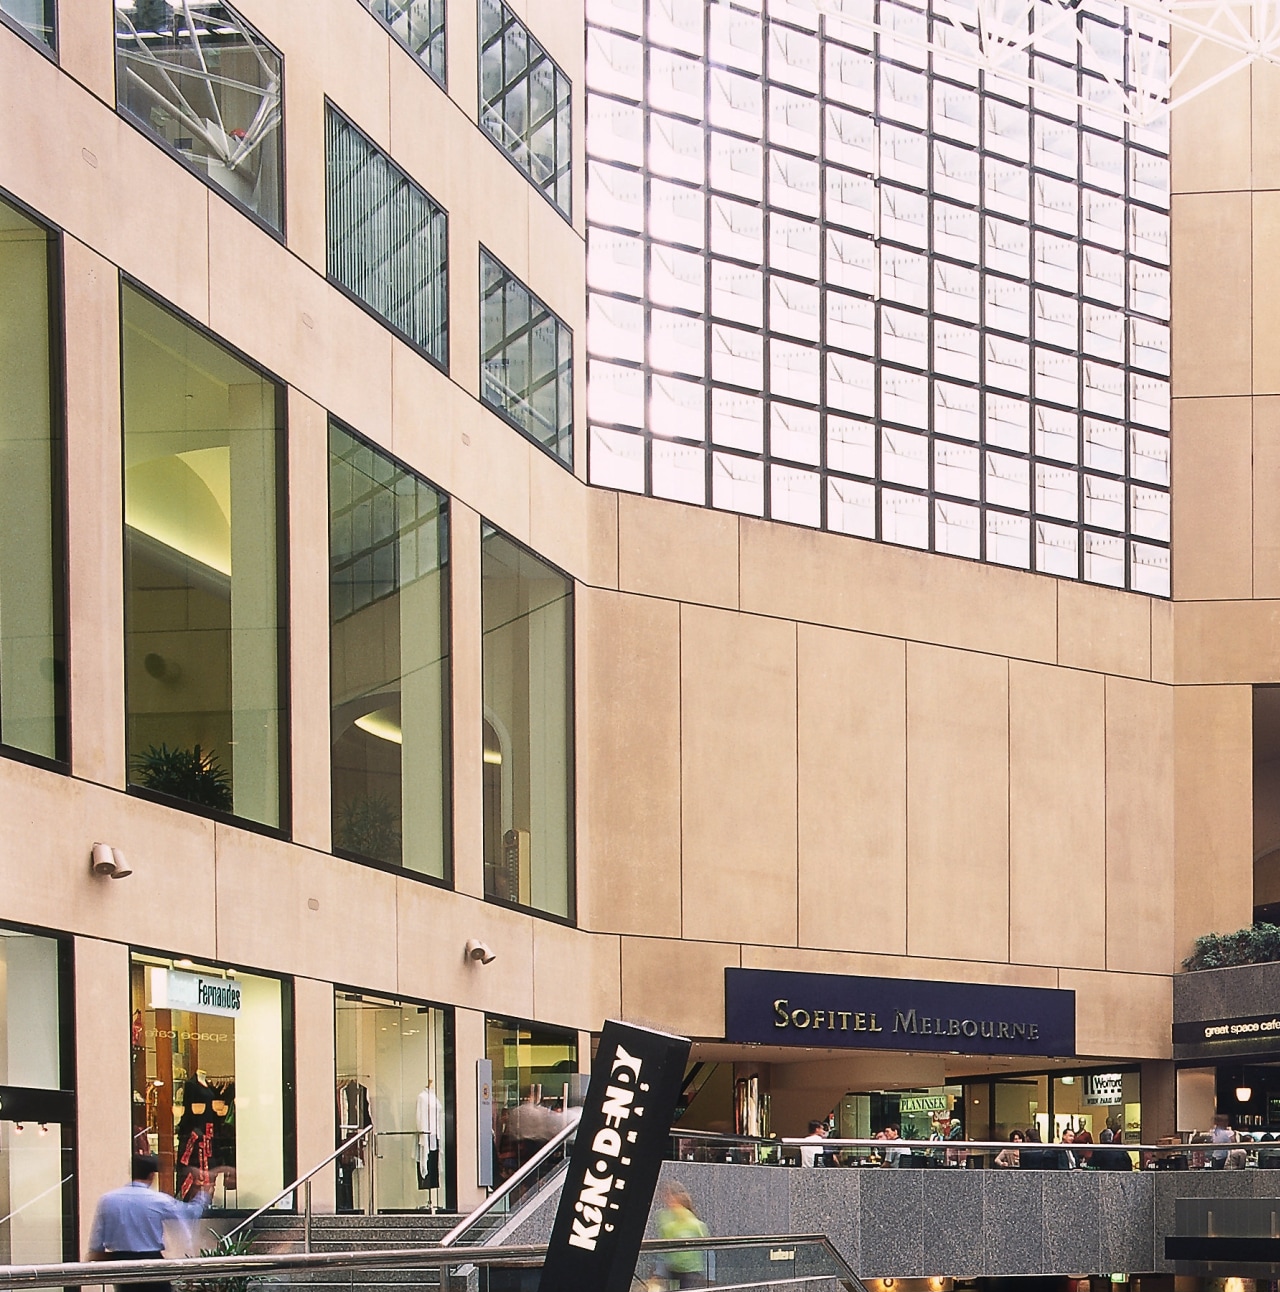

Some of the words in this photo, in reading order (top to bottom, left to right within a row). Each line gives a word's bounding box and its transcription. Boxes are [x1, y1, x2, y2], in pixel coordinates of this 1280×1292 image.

[198, 979, 241, 1010] Fernandes
[773, 999, 883, 1032] SOFITEL
[892, 1008, 1040, 1040] MELBOURNE
[1204, 1024, 1229, 1038] great
[1230, 1022, 1259, 1035] space
[1260, 1018, 1280, 1031] cafe
